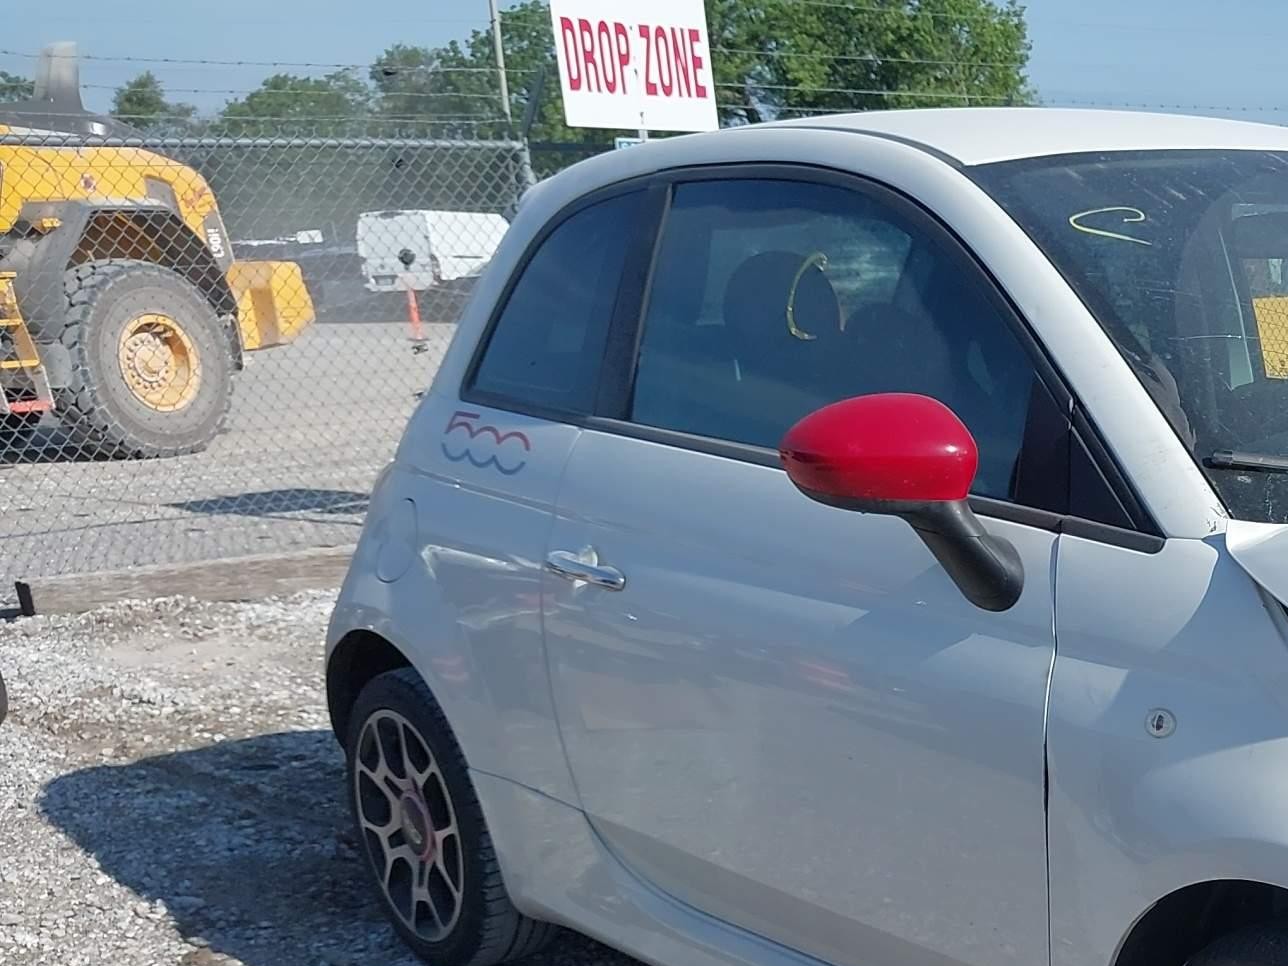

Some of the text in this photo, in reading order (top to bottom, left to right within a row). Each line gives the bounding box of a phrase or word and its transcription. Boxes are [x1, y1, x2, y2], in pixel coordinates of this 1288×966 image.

[560, 17, 708, 99] DROP ZONE
[441, 411, 530, 475] 500
